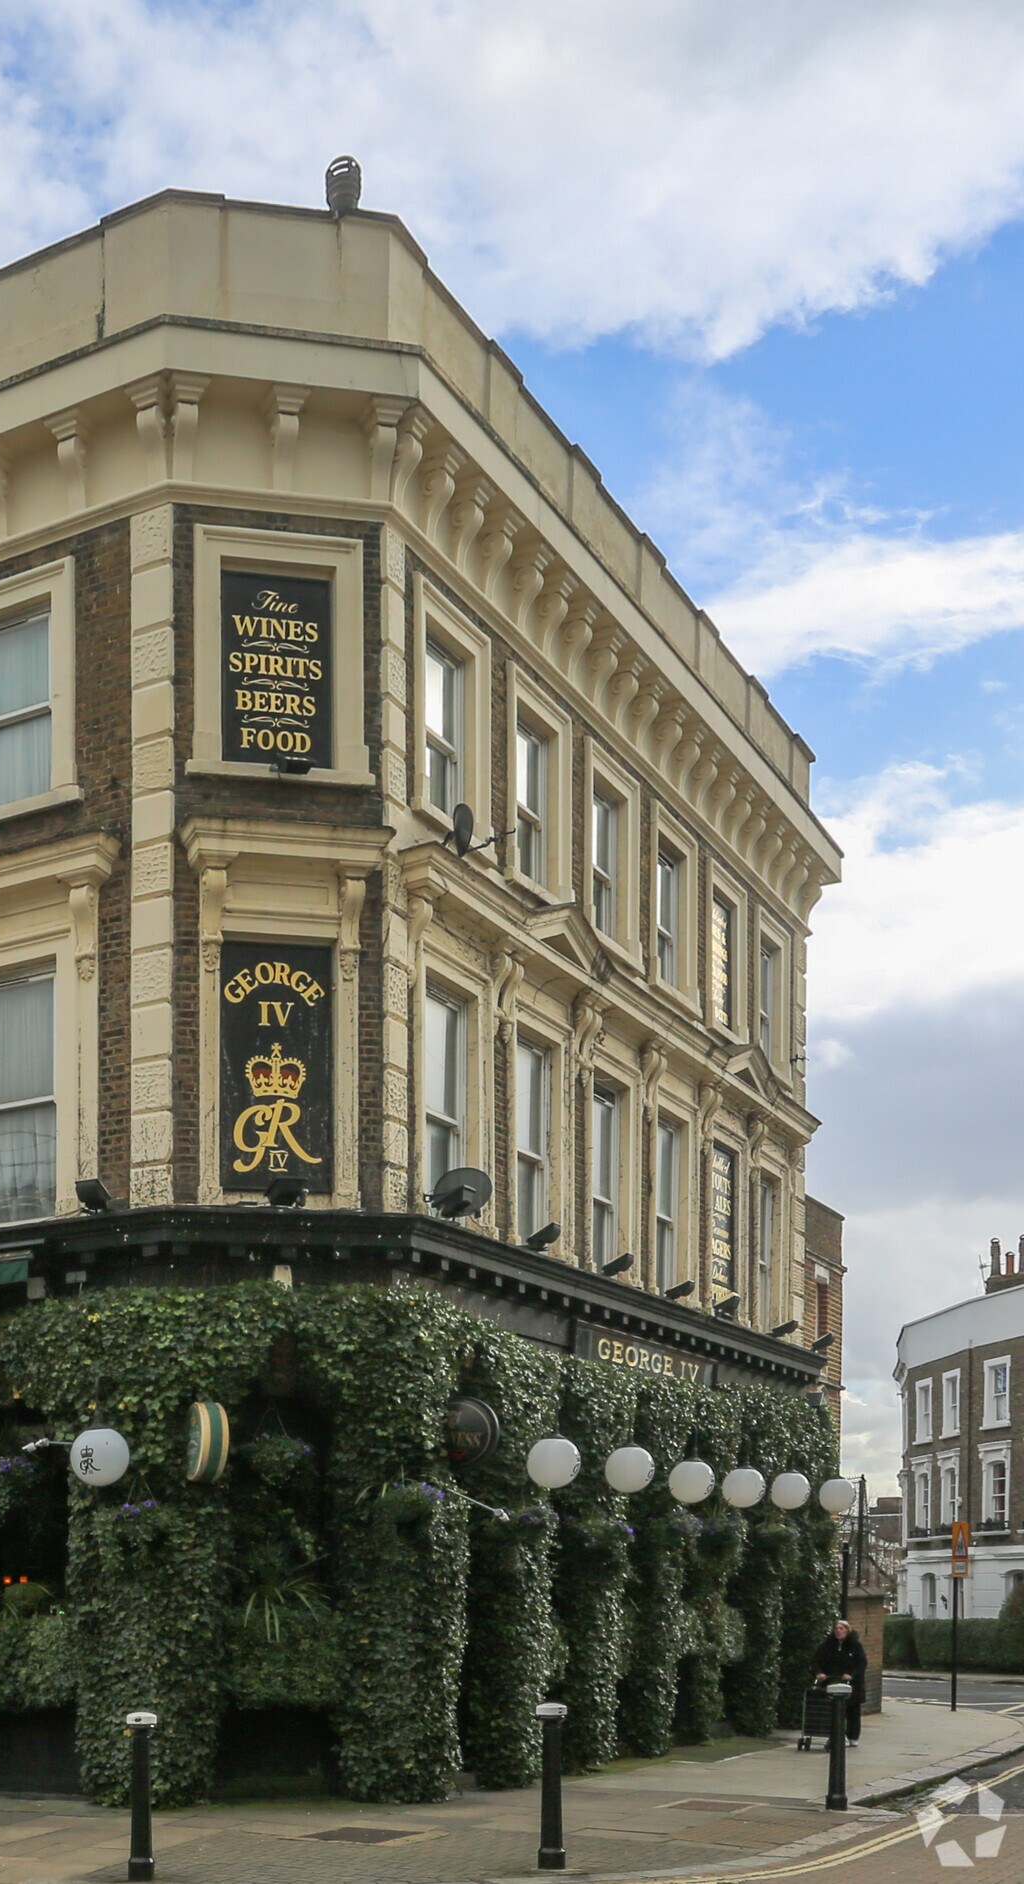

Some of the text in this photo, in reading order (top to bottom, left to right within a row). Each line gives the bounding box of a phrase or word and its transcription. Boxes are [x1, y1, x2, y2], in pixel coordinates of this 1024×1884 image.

[251, 590, 300, 614] Fine
[231, 614, 319, 643] WINES
[228, 651, 323, 681] SPIRITS
[235, 689, 317, 717] BEERS
[240, 726, 312, 753] FOOD
[223, 960, 325, 1027] GEORGE IV
[232, 1098, 323, 1172] GR
[268, 1150, 289, 1172] IV
[712, 1171, 731, 1196] TOUTS
[714, 1194, 732, 1217] ALES
[712, 1238, 732, 1261] AGERS
[597, 1337, 700, 1382] GEORGE IV
